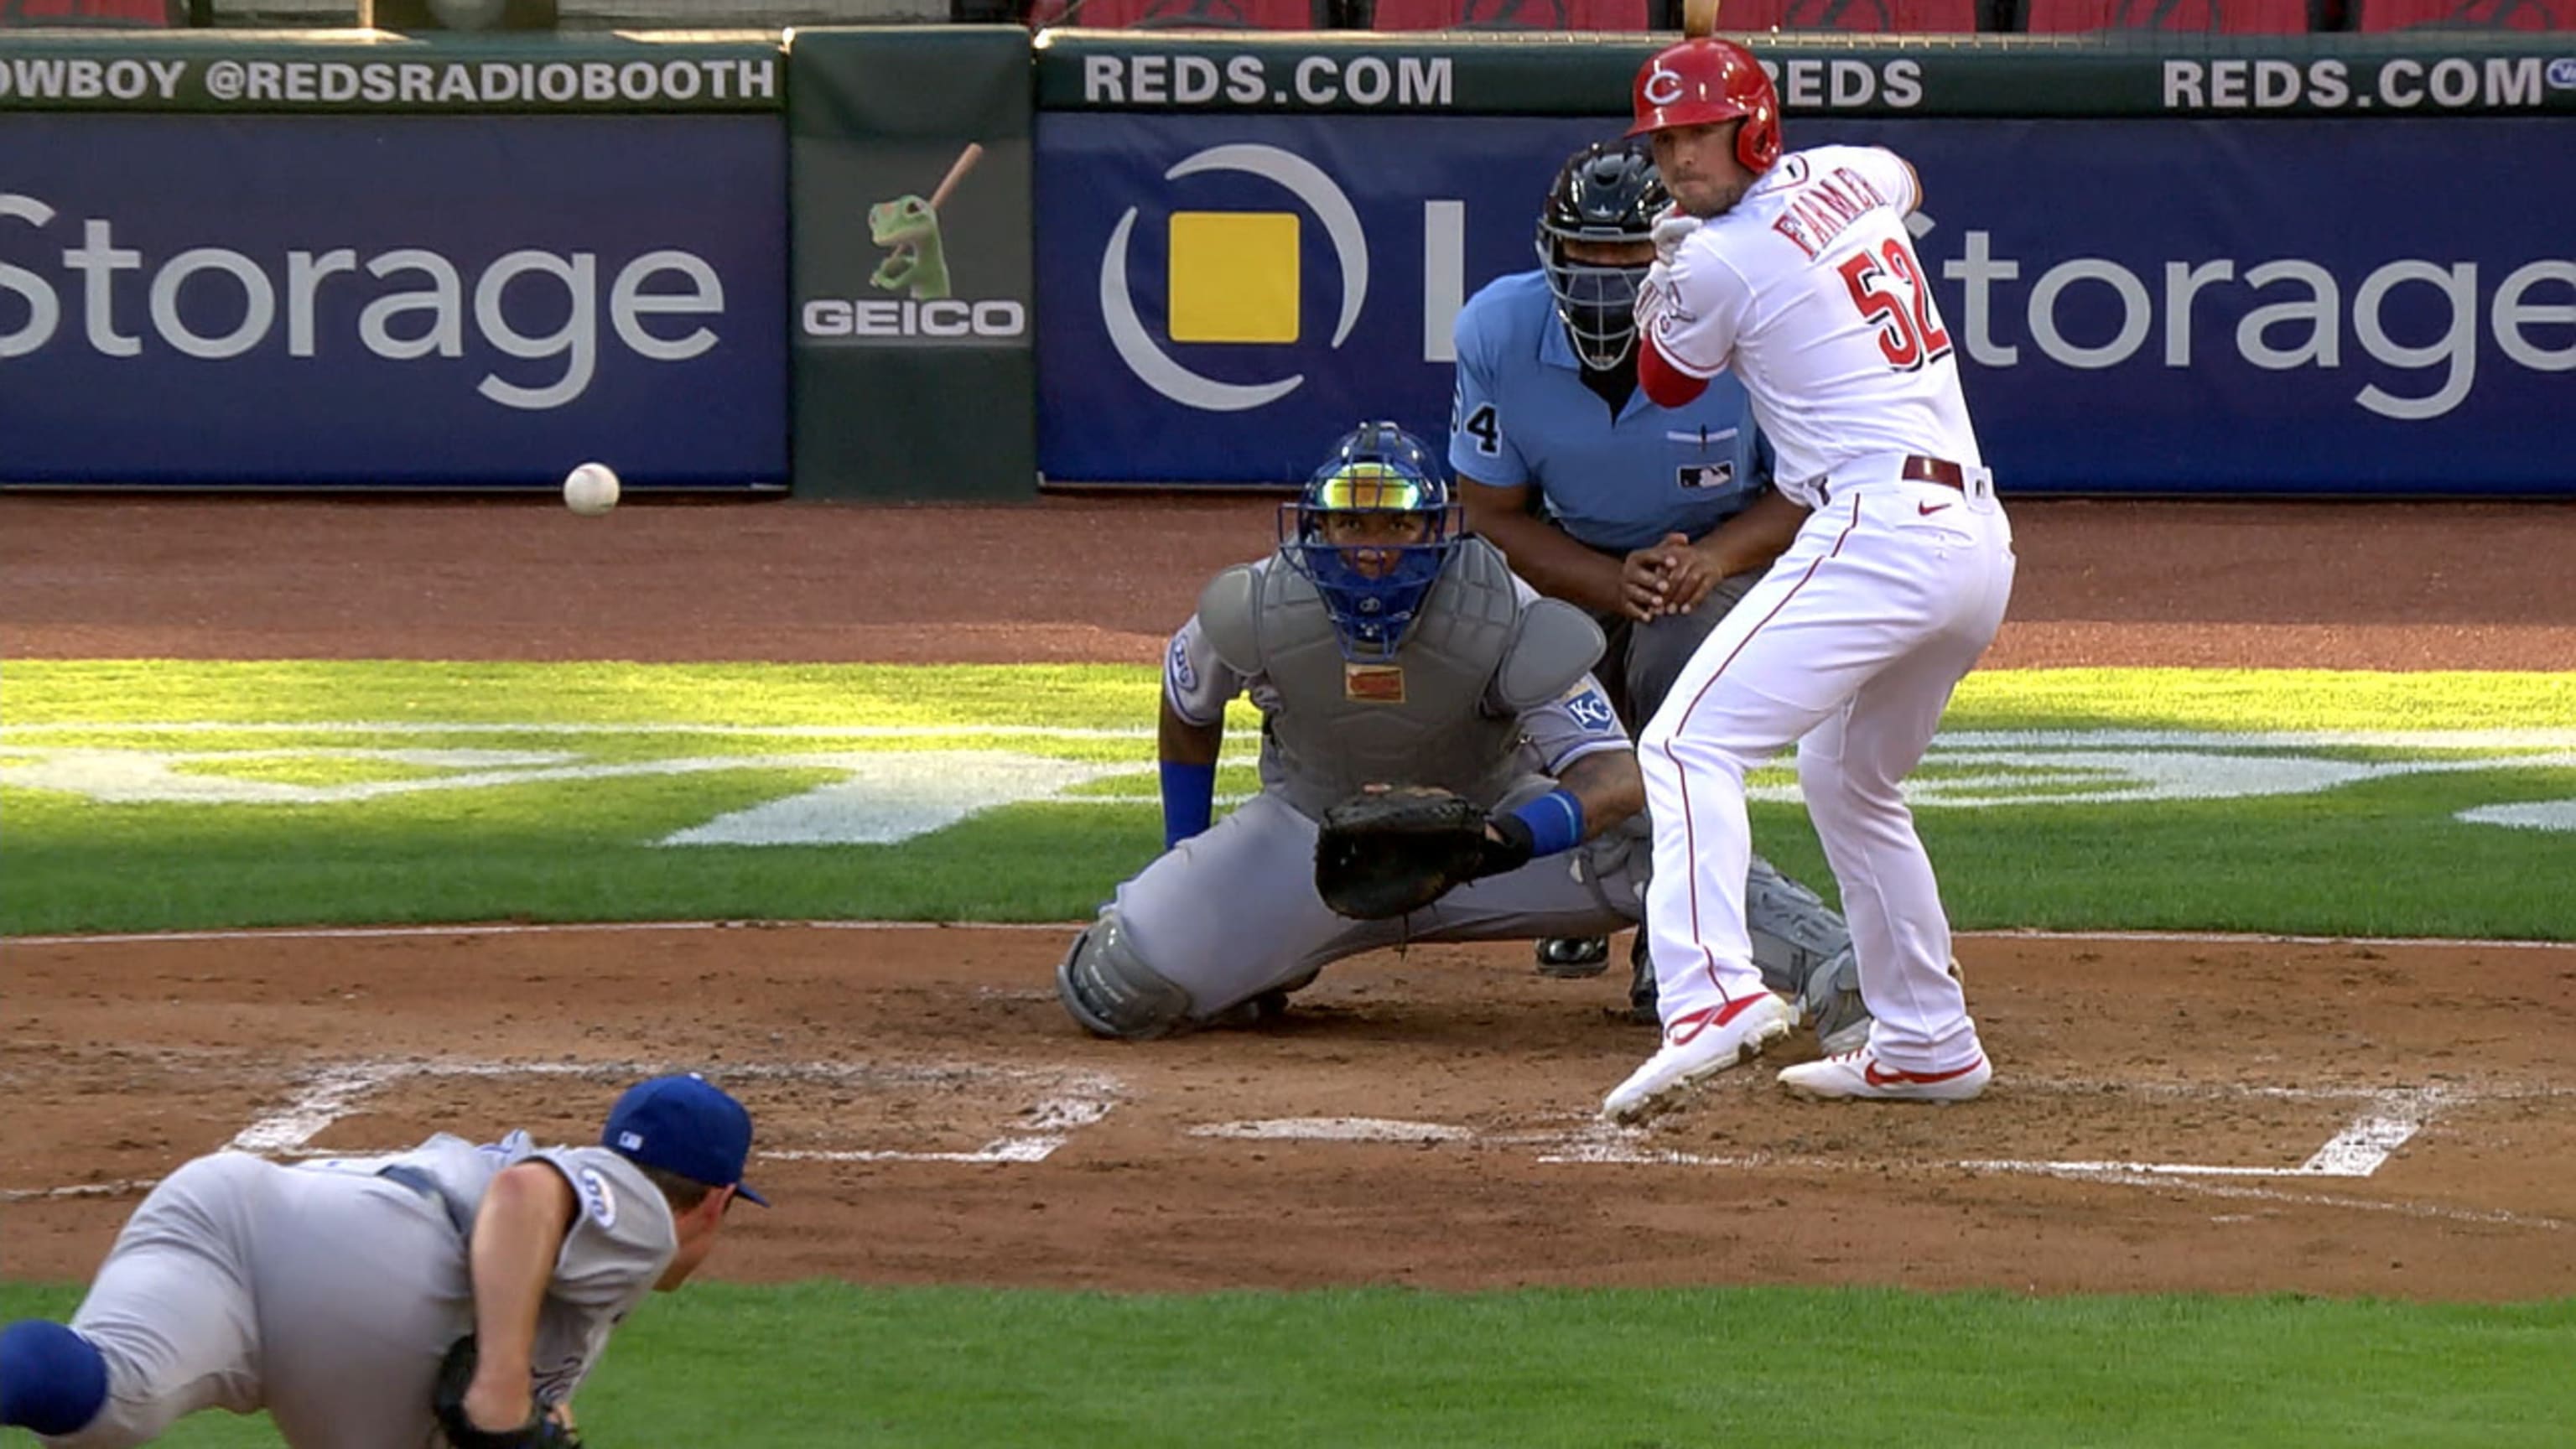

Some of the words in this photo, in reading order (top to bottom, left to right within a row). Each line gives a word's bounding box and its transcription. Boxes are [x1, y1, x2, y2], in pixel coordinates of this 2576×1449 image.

[0, 59, 187, 100] WBOY
[206, 60, 774, 101] @REDSRADIOBOOTH
[1085, 55, 1453, 104] REDS.COM
[2163, 58, 2542, 106] REDS.COM
[0, 194, 724, 410] Storage
[802, 299, 1025, 338] GEICO
[1837, 237, 1953, 372] 52
[1903, 209, 2576, 420] torage
